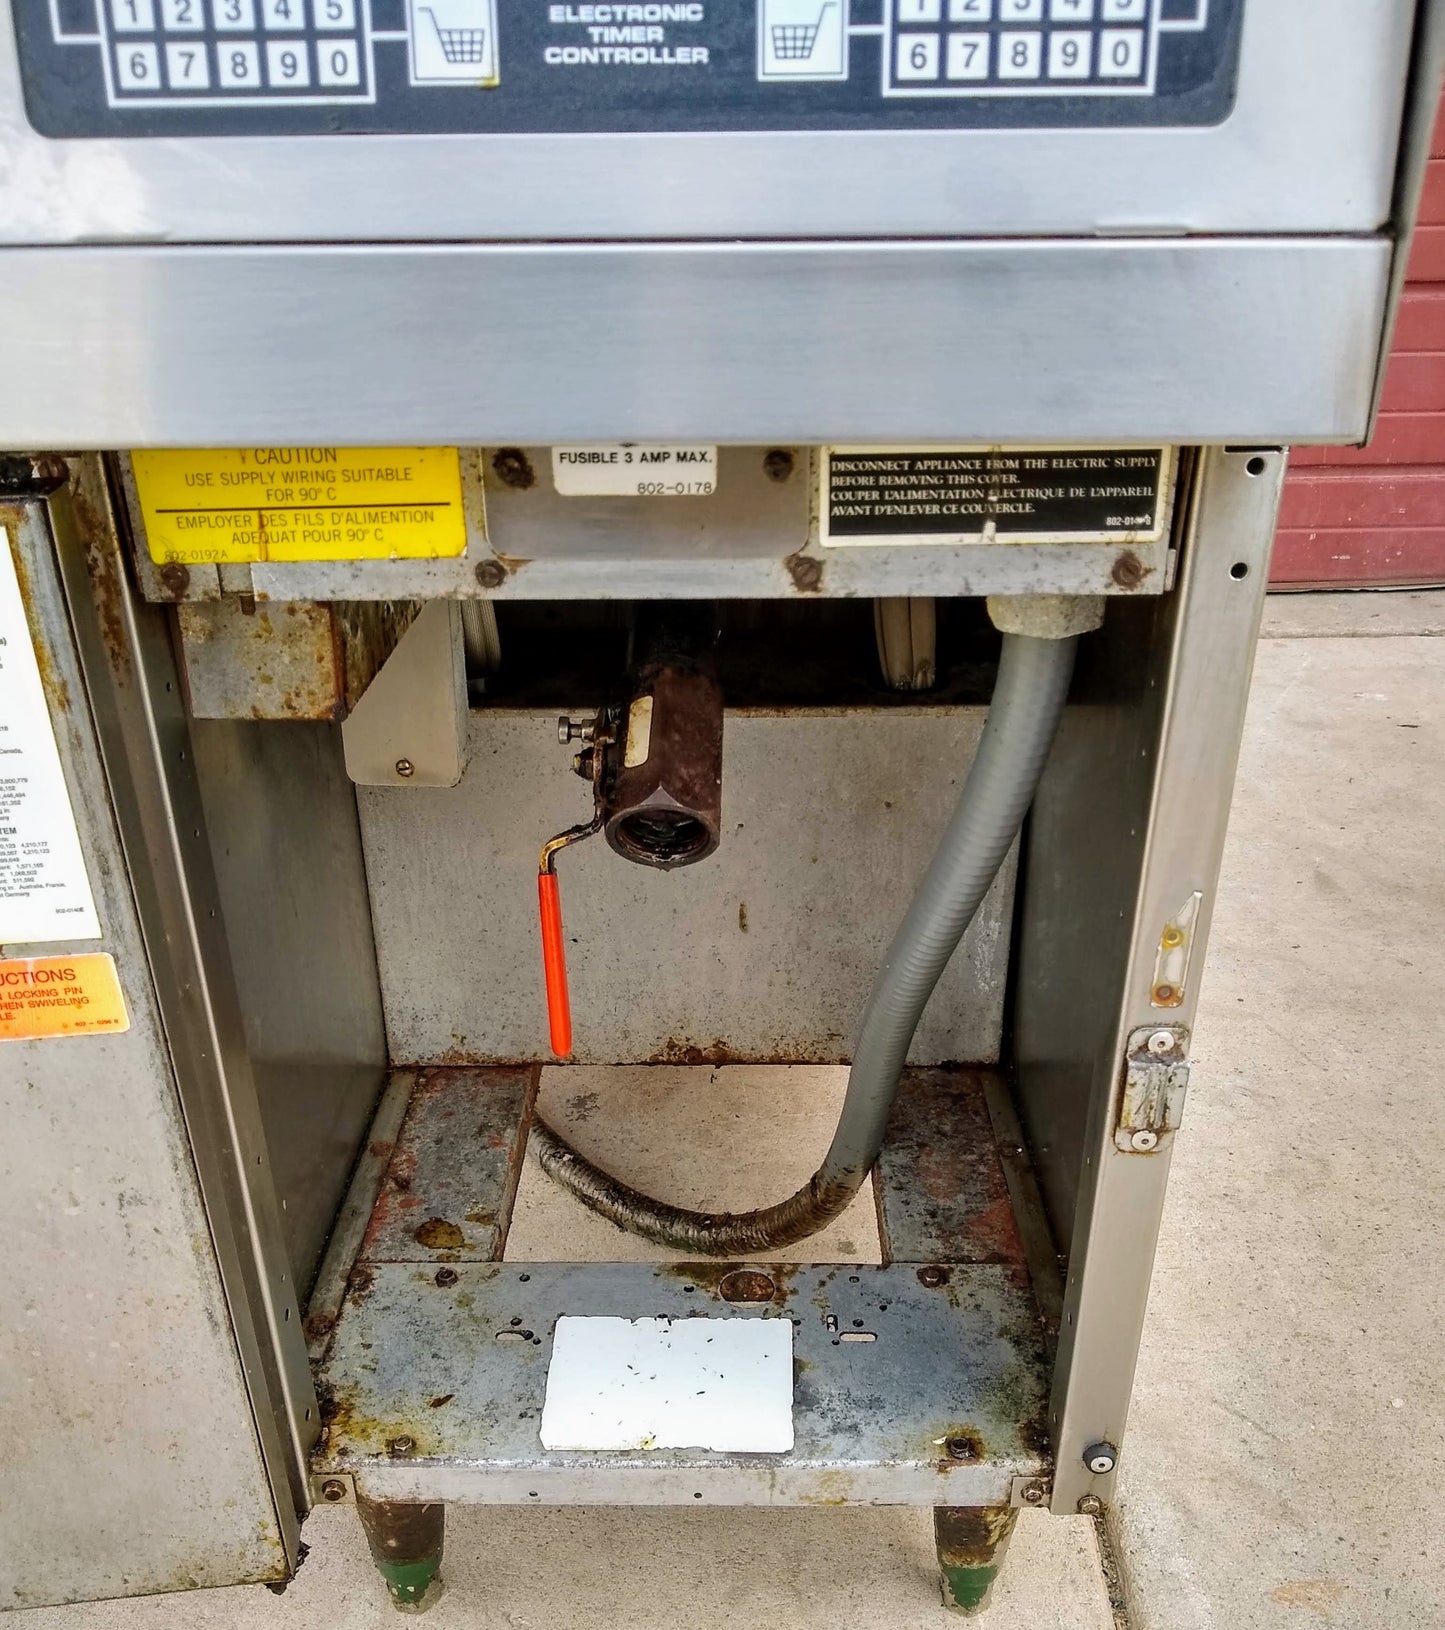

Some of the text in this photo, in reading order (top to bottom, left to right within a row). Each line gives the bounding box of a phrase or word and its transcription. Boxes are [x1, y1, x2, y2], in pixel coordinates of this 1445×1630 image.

[176, 0, 192, 22] 2
[225, 0, 241, 22] 3
[274, 0, 291, 20] 4
[326, 0, 343, 20] 5
[549, 4, 704, 23] ELECTRONIC
[587, 26, 664, 44] TIMER
[544, 46, 709, 64] CONTROLLER
[910, 40, 1130, 69] 6 7 8 9 0
[130, 50, 348, 79] 6 7 8 9 0
[254, 448, 337, 464] CAUTION
[560, 451, 713, 464] FUSIBLE 3 AMP MAX.
[831, 457, 1158, 472] DISCONNECT APPLIANCE FROM THE ELECTRIC SUPPLY
[185, 467, 414, 487] USE SUPPLY WIRING SUITABLE
[831, 474, 1020, 486] BEFORE REMOVING THIS COVER.
[266, 488, 294, 502] FOR
[326, 488, 336, 500] C
[636, 482, 712, 494] 802-0178
[831, 490, 880, 502] COUPER
[884, 489, 984, 500] L'ALIMENTATION
[1070, 488, 1086, 498] DE
[1090, 486, 1154, 498] L'APPAREIL
[831, 502, 1036, 516] AVANT D'ENLEVER CE COUVERCLE.
[176, 510, 435, 530] EMPLOYER DES FILS D'ALIMENTION
[232, 530, 297, 545] ADEQUAT
[303, 528, 342, 544] POUR
[374, 528, 384, 542] C
[8, 988, 58, 1000] LOCKING
[64, 987, 82, 996] PIN
[28, 996, 90, 1009] SWIVELING
